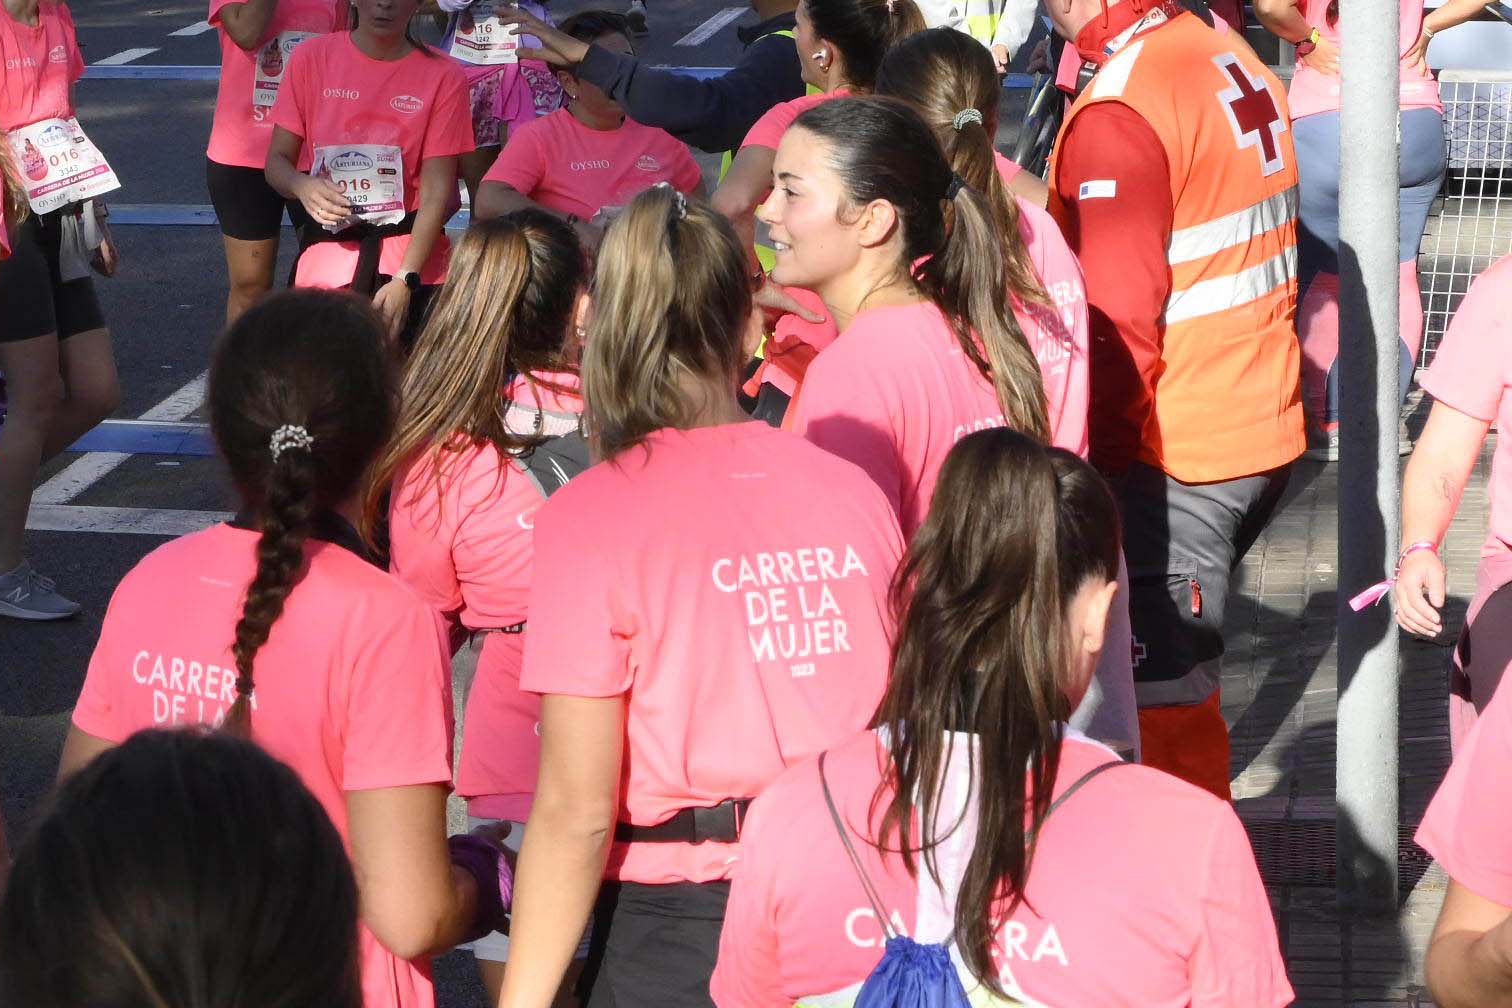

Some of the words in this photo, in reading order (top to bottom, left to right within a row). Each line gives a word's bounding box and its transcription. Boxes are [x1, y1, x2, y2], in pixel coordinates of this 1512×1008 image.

[570, 158, 610, 172] OYSHO
[711, 544, 869, 593] CARRERA
[745, 588, 789, 625] DE
[797, 583, 841, 620] LA
[747, 619, 852, 663] MUJER
